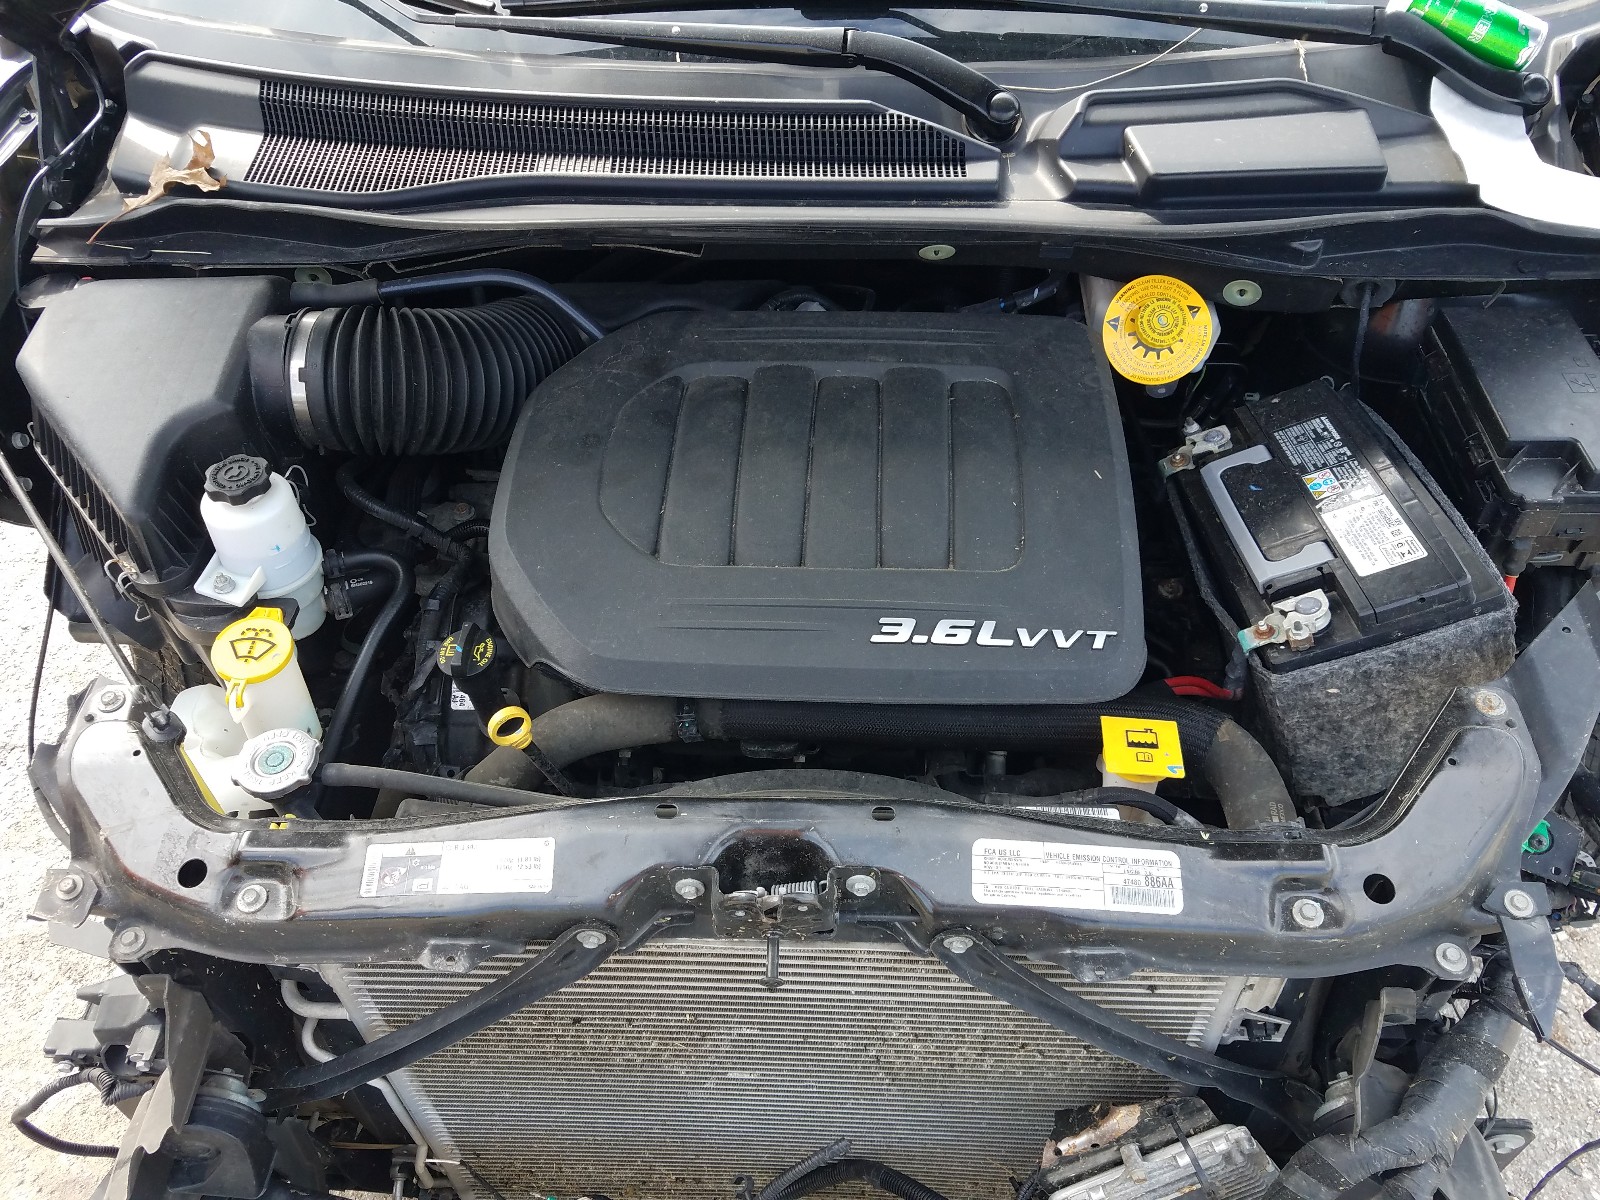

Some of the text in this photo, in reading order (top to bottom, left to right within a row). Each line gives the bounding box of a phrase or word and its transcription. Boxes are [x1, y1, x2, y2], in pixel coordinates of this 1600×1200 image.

[869, 617, 1118, 649] 3.6L VVT
[477, 637, 494, 667] ENGINE OIL
[983, 848, 1021, 857] FCA US LLC
[1045, 851, 1070, 860] VEHICLE
[1072, 853, 1101, 862] EMISSION
[1103, 855, 1129, 865] CONTROL
[1131, 858, 1173, 867] INFORMATION
[1144, 876, 1174, 889] 886AA
